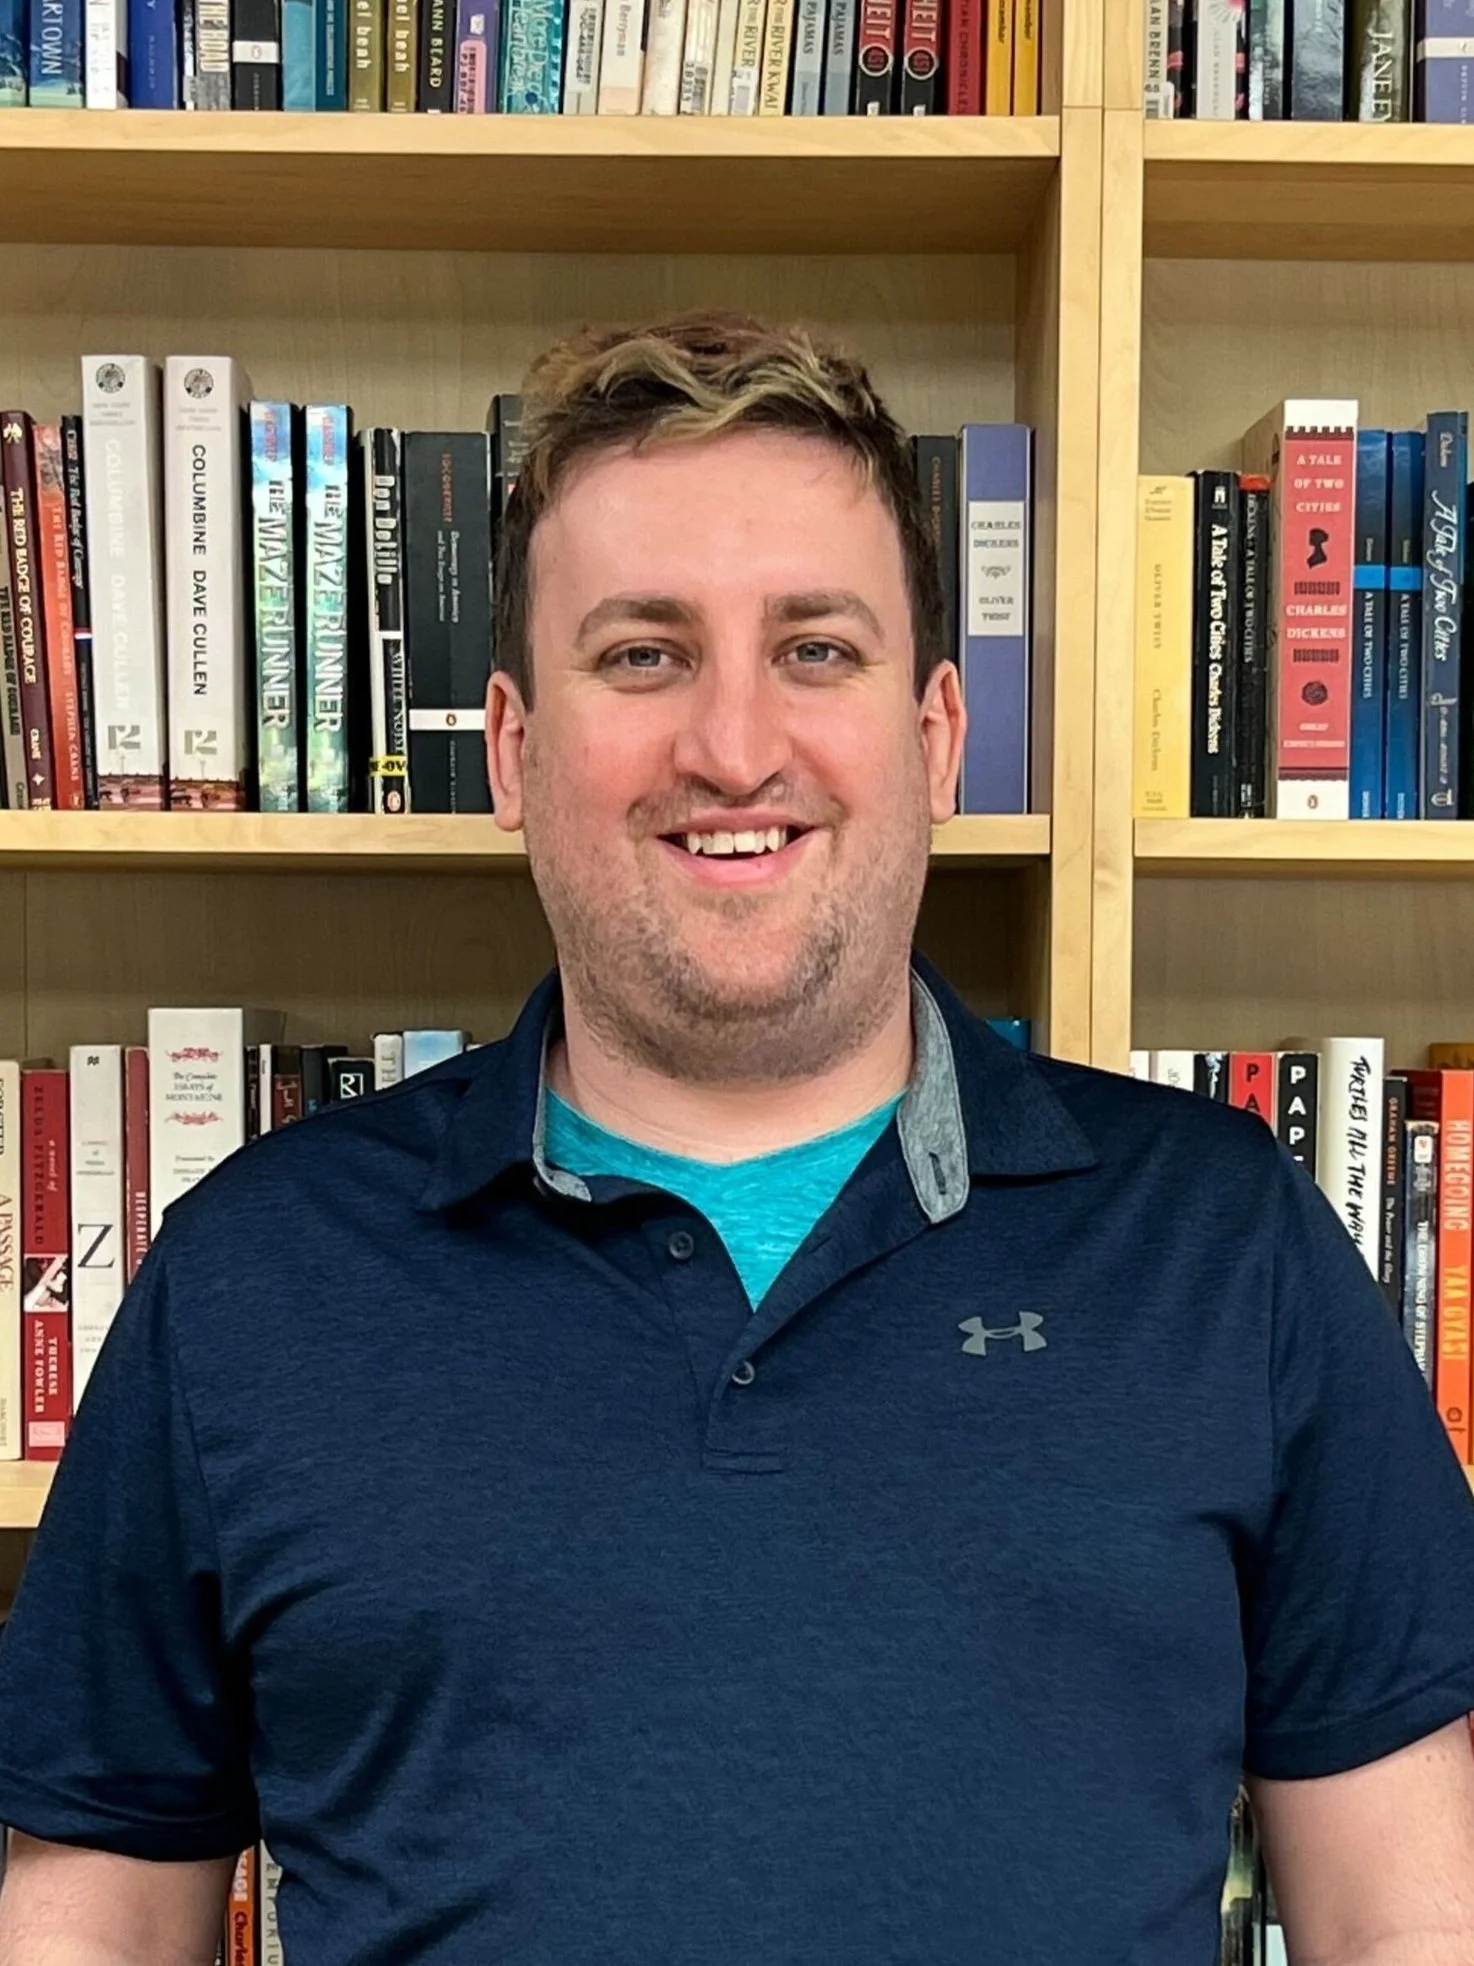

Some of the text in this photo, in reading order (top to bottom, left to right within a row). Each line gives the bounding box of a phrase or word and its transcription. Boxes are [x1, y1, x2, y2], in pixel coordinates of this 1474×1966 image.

[356, 26, 372, 69] beah
[616, 4, 632, 57] Berryman
[741, 25, 759, 67] RIVER
[767, 25, 786, 67] RIVER
[801, 1, 818, 55] PAJAMAS
[831, 2, 848, 56] PAJAMAS
[199, 29, 229, 73] ROAD
[394, 30, 410, 73] beah
[429, 36, 443, 89] BEARD
[1366, 27, 1394, 94] JANE
[763, 71, 781, 109] KWAI
[1297, 454, 1342, 465] A TALE
[269, 480, 286, 514] THE
[324, 485, 341, 518] THE
[1294, 479, 1344, 489] OF TWO
[1296, 501, 1341, 512] CITIES
[1431, 490, 1457, 524] A
[374, 475, 398, 585] Don DeLillo
[1430, 519, 1457, 553] Tale
[104, 439, 129, 710] COLUMBINE DAVE CULLEN
[192, 444, 207, 695] COLUMBINE DAVE CULLEN
[258, 517, 288, 602] MAZE
[314, 520, 345, 604] MAZE
[1426, 549, 1453, 577] of
[1286, 604, 1347, 616] CHARLES
[1365, 592, 1373, 600] A
[1401, 594, 1409, 602] A
[1429, 573, 1457, 612] Two
[10, 488, 41, 760] THE RED BADGE OF COURAGE CRANE
[1208, 524, 1227, 754] A Tale of Two Cities Charles Dickens
[1287, 628, 1346, 639] DICKENS
[1434, 616, 1457, 661] Cities
[261, 606, 294, 729] RUNNER
[314, 611, 345, 732] RUNNER
[1363, 641, 1373, 665] TWO
[1349, 1056, 1371, 1121] TURTLES
[34, 1086, 44, 1245] ZELDA FITZGERALD
[48, 1151, 57, 1177] novel
[1346, 1127, 1368, 1160] ALL
[47, 1181, 58, 1192] of
[1348, 1165, 1366, 1197] THE
[1444, 1120, 1470, 1231] HOMEGOING
[135, 1192, 148, 1253] DESPERATE
[1417, 1222, 1429, 1244] THE
[0, 1212, 14, 1291] PASSAGE
[77, 1223, 115, 1269] Z
[1443, 1265, 1468, 1361] YAA GYASI
[34, 1320, 44, 1413] ANNE FOWLER
[48, 1337, 57, 1396] THERESE
